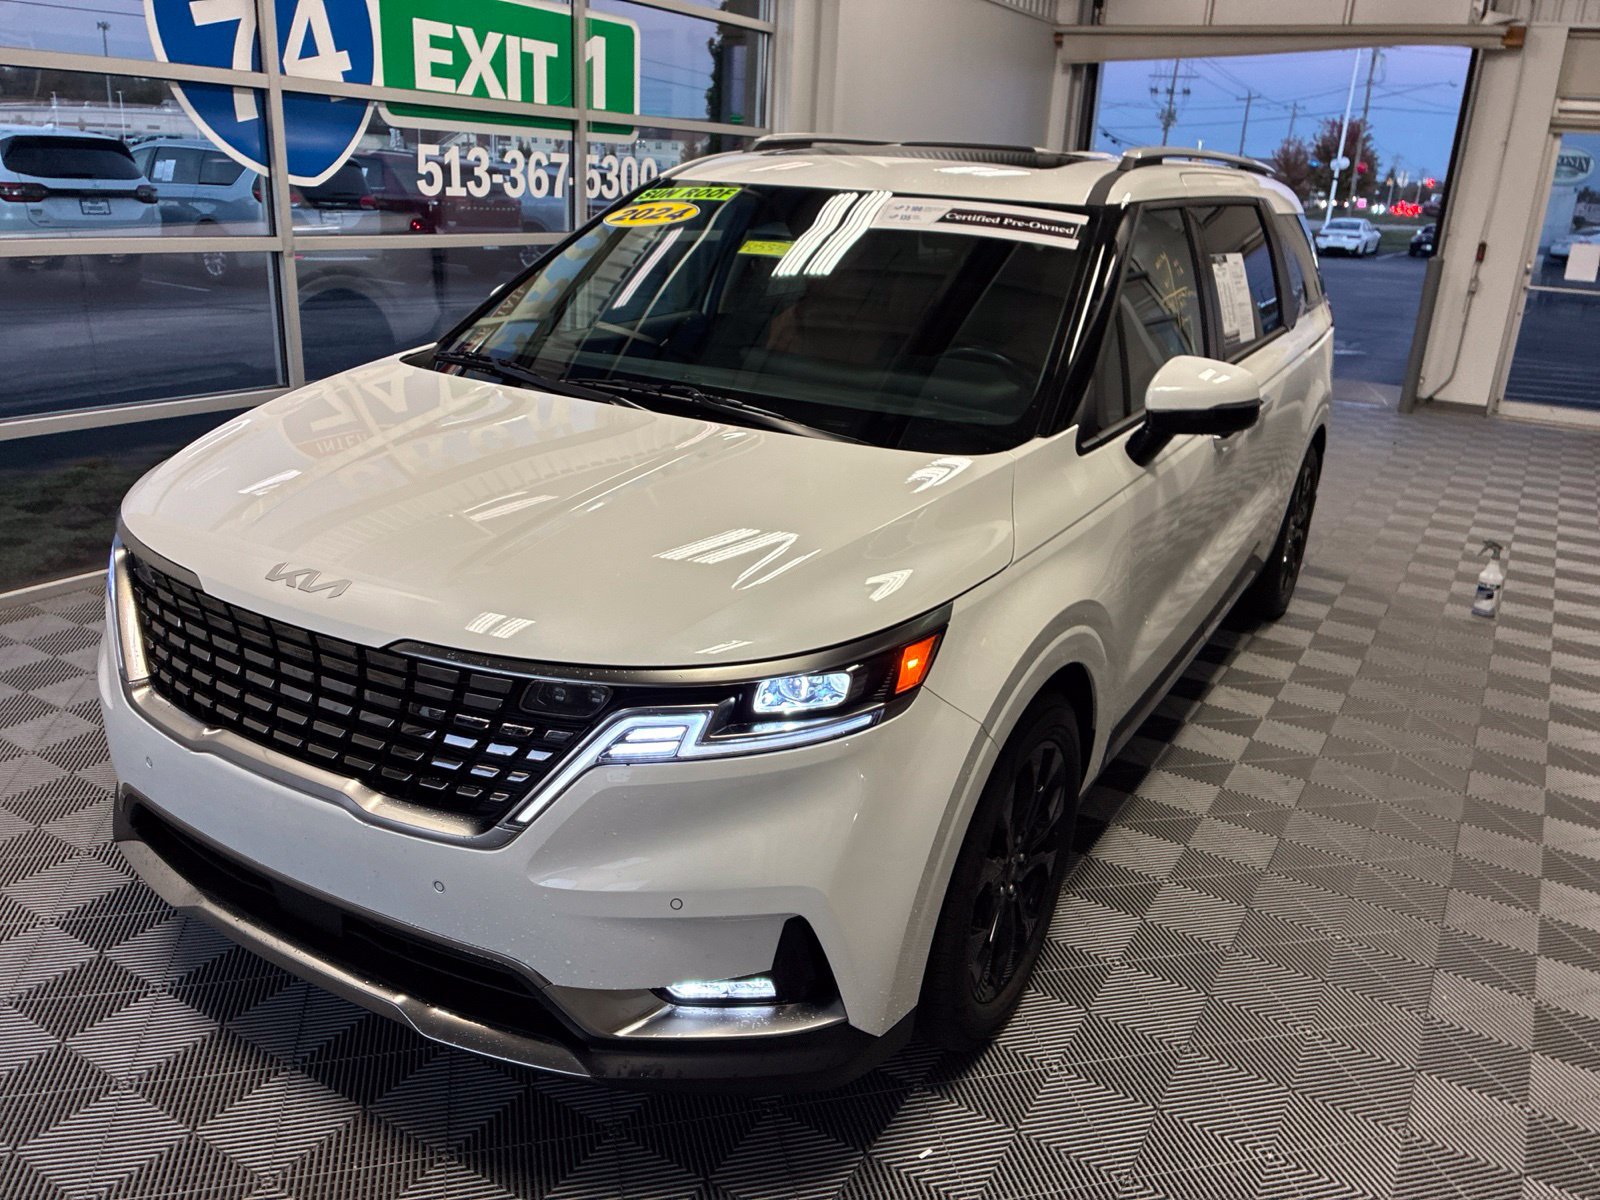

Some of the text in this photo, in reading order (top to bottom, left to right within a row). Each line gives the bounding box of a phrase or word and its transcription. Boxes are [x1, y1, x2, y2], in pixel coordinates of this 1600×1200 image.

[189, 0, 352, 123] 74
[412, 17, 606, 110] EXIT 1
[641, 187, 738, 200] SUN ROOF
[611, 207, 693, 222] 2024
[945, 211, 1075, 235] Certified Pre-Owned
